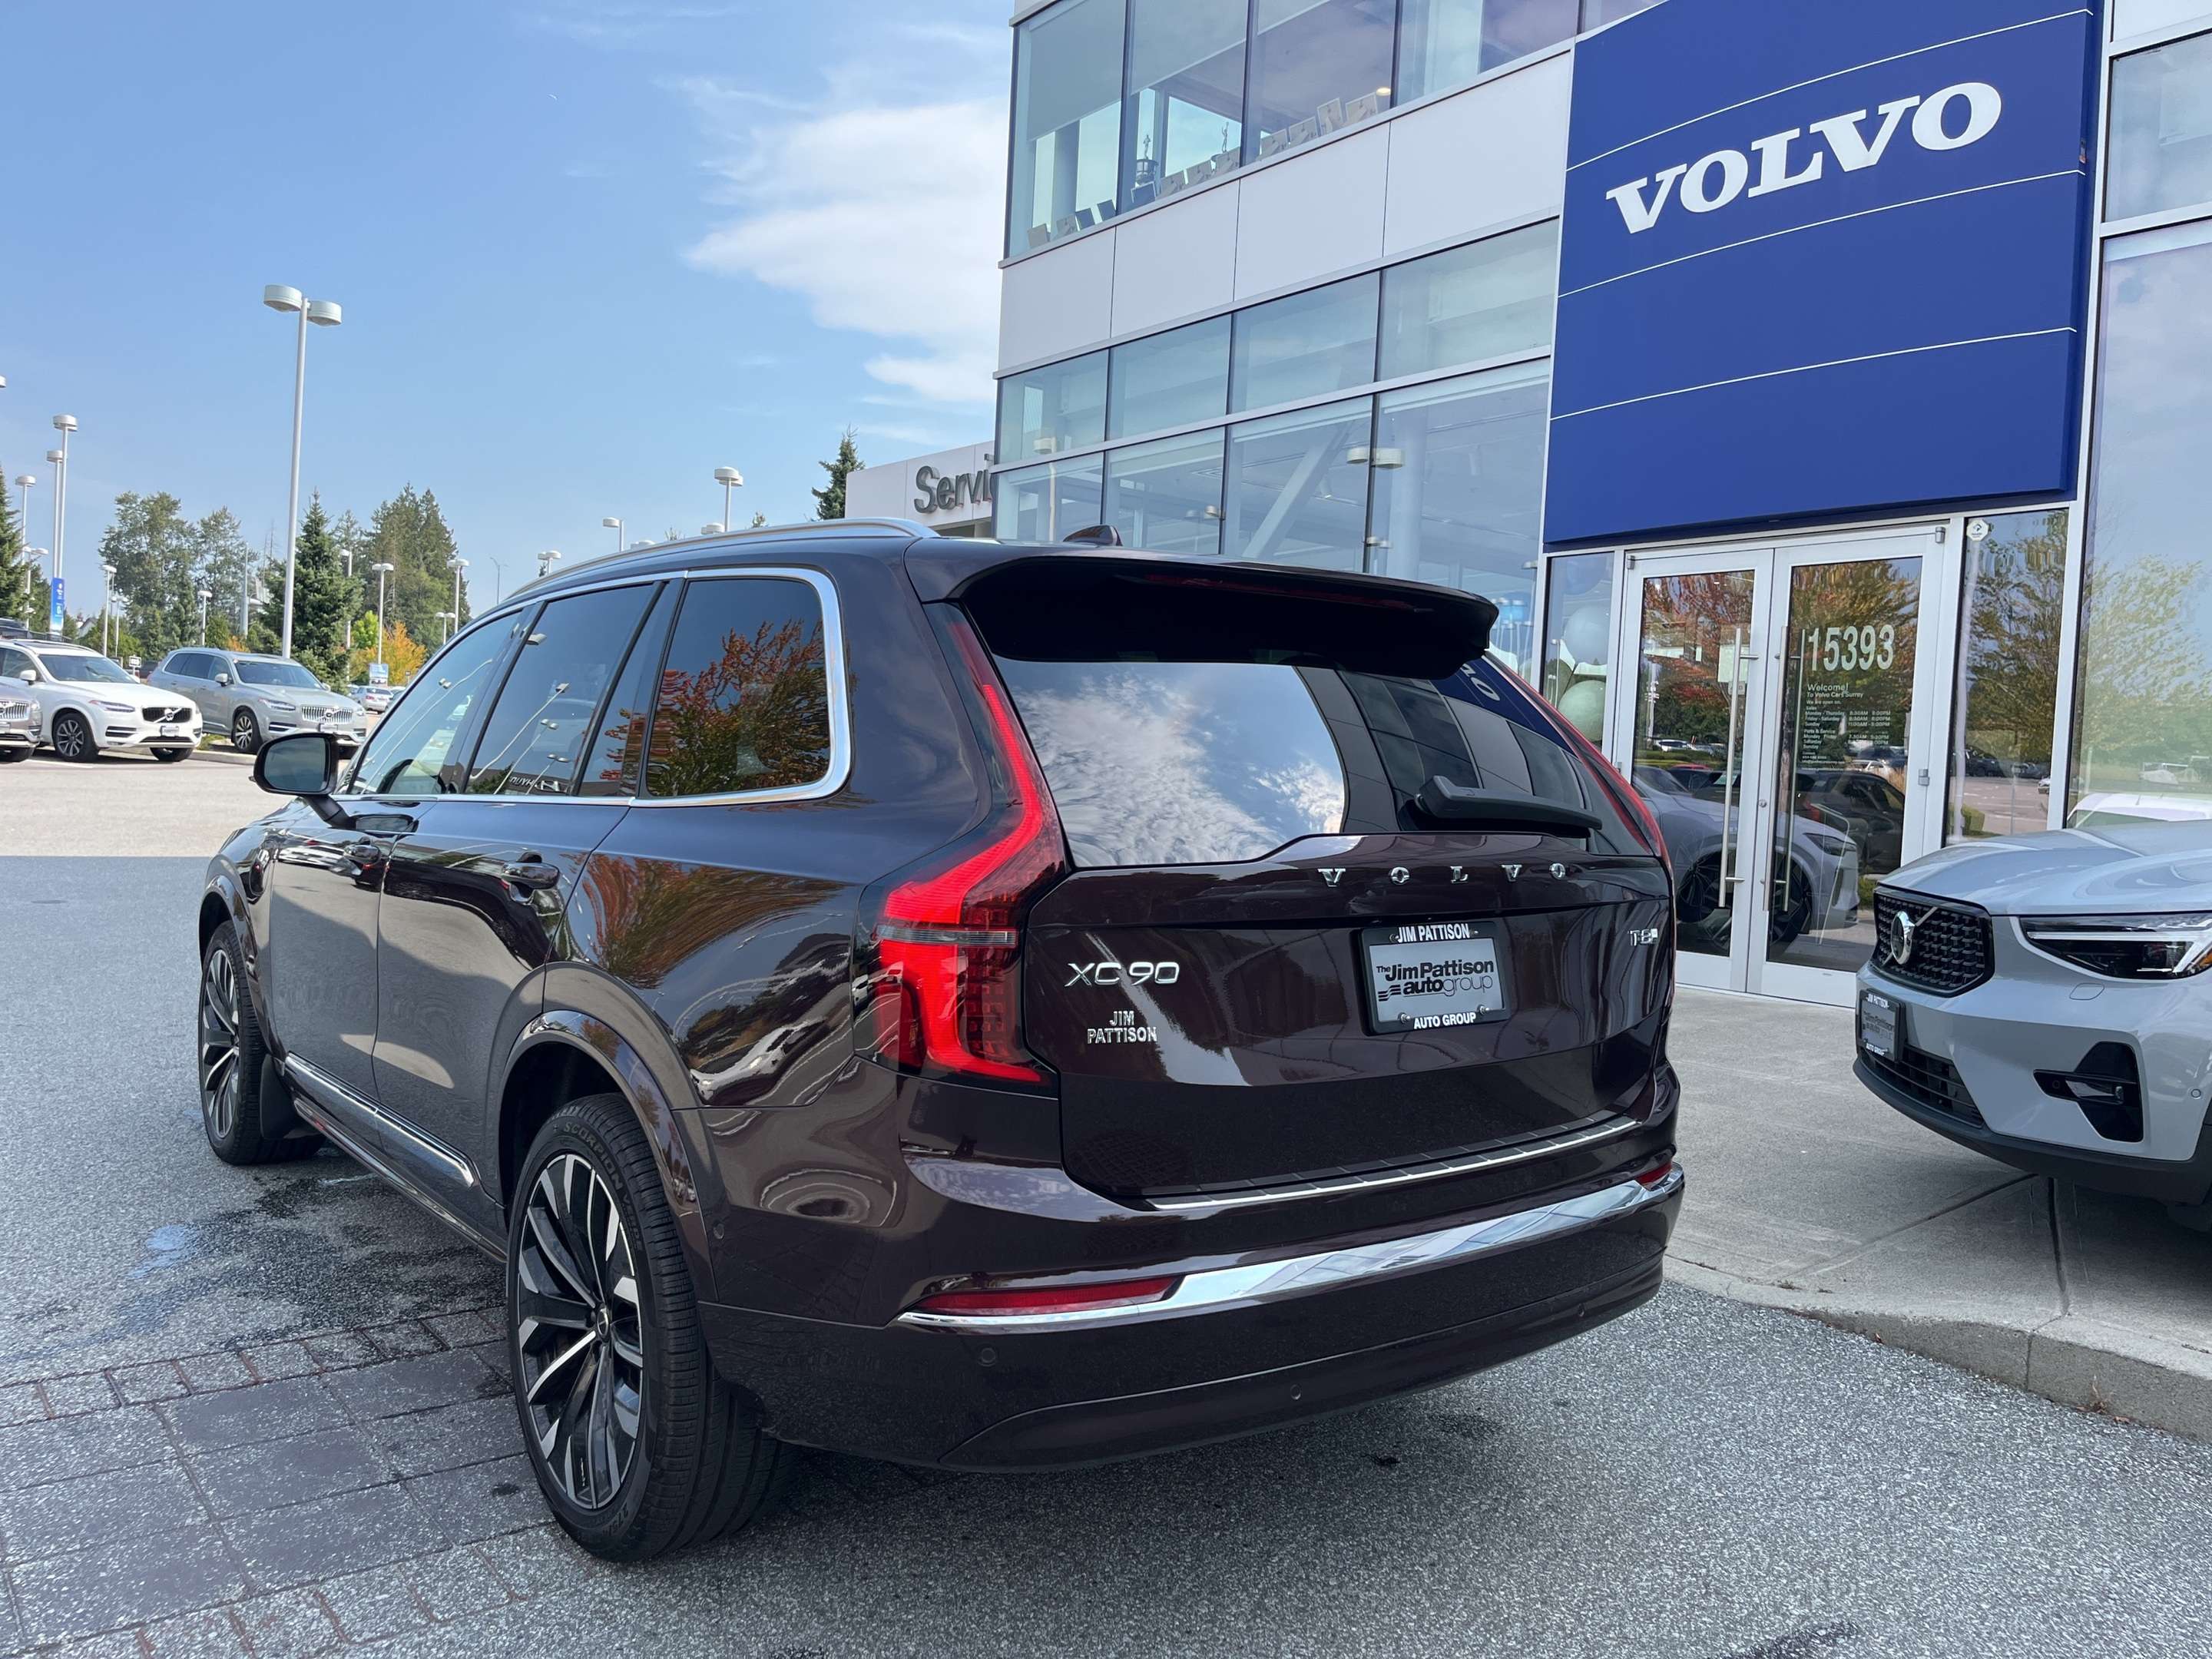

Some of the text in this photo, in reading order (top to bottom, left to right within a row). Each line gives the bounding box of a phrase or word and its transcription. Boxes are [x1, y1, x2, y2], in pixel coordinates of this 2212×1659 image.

[1605, 81, 2002, 234] VOLVO
[914, 453, 995, 513] Servi
[1808, 624, 1895, 671] 15393
[1807, 683, 1848, 691] Welcome!
[1317, 862, 1566, 887] VOLVO
[1397, 923, 1470, 943] JIM PATTISON
[1109, 1011, 1134, 1026] JIM
[1414, 1012, 1476, 1029] AUTO GROUP
[1087, 1027, 1157, 1045] PATTISON
[563, 1121, 624, 1190] SCORPION
